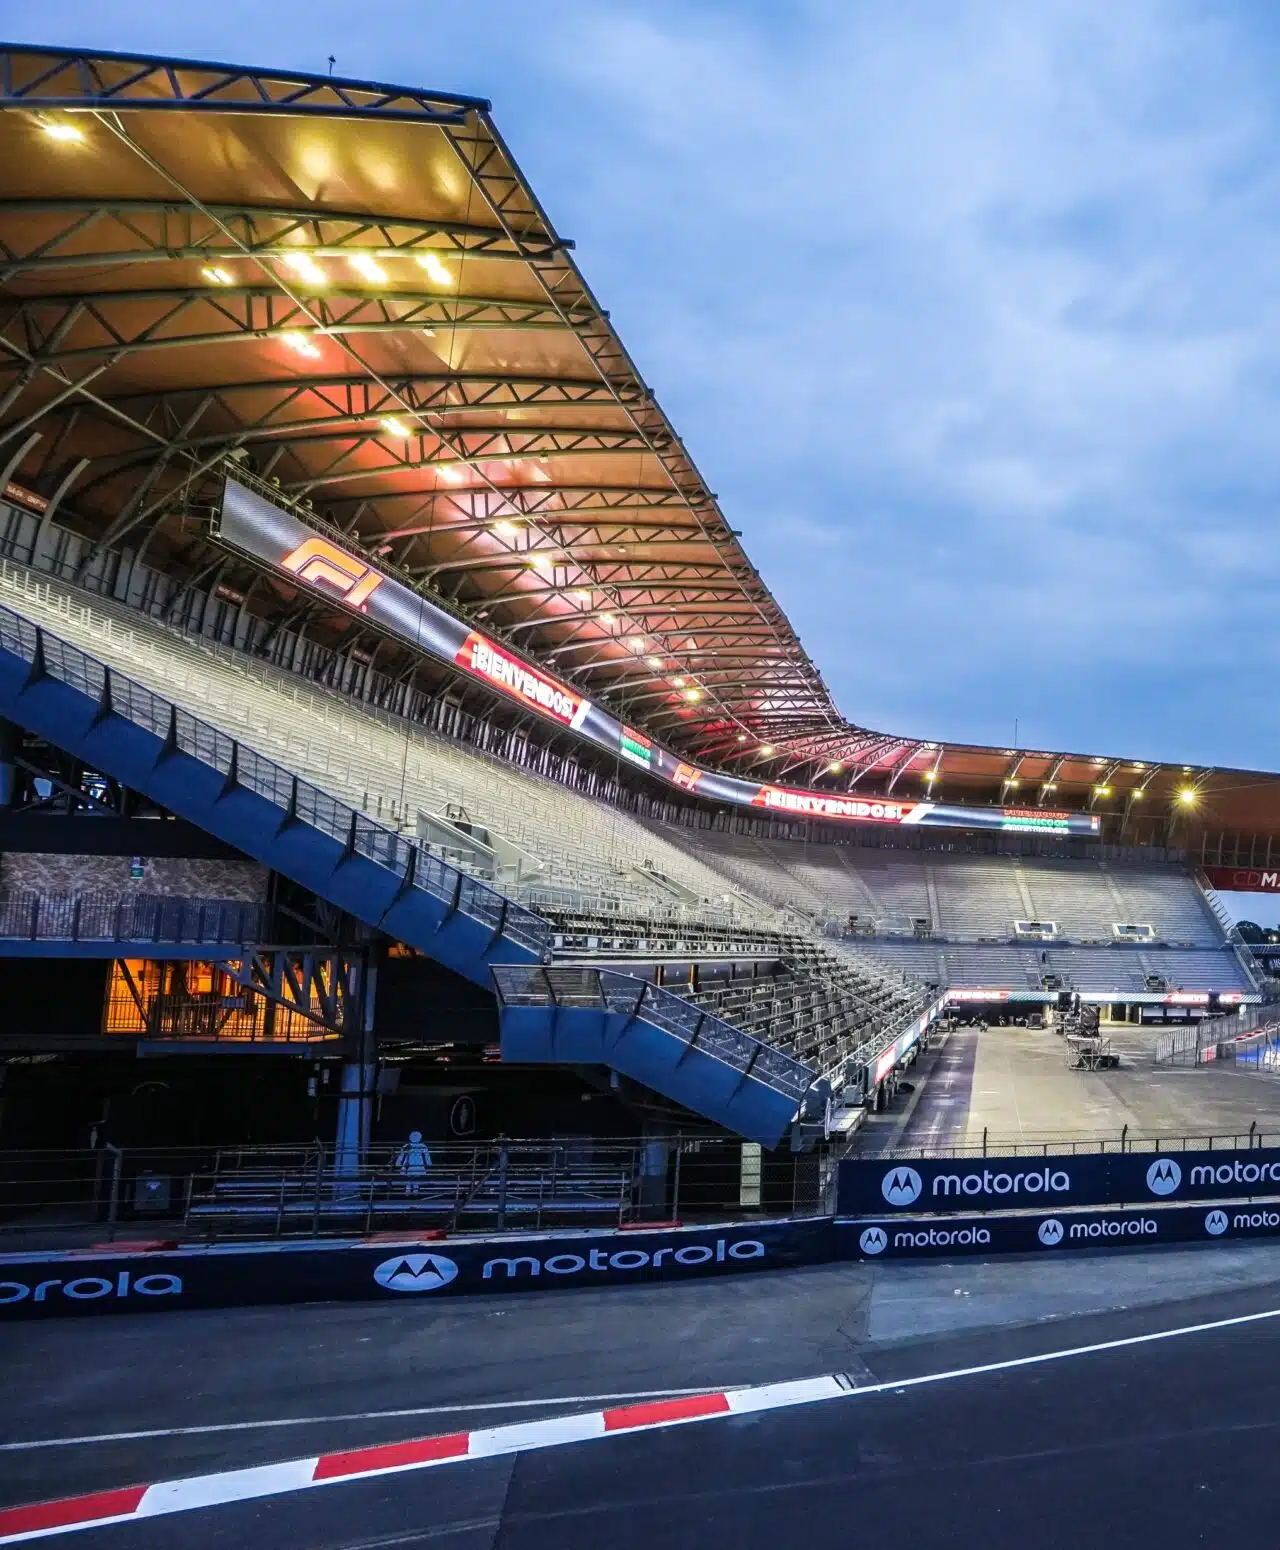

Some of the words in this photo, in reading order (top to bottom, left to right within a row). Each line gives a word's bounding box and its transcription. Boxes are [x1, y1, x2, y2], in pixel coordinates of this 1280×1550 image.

[933, 1167, 1070, 1195] motorola
[894, 1226, 990, 1247] motorola
[1070, 1218, 1157, 1238] motorola
[482, 1239, 765, 1279] motorola
